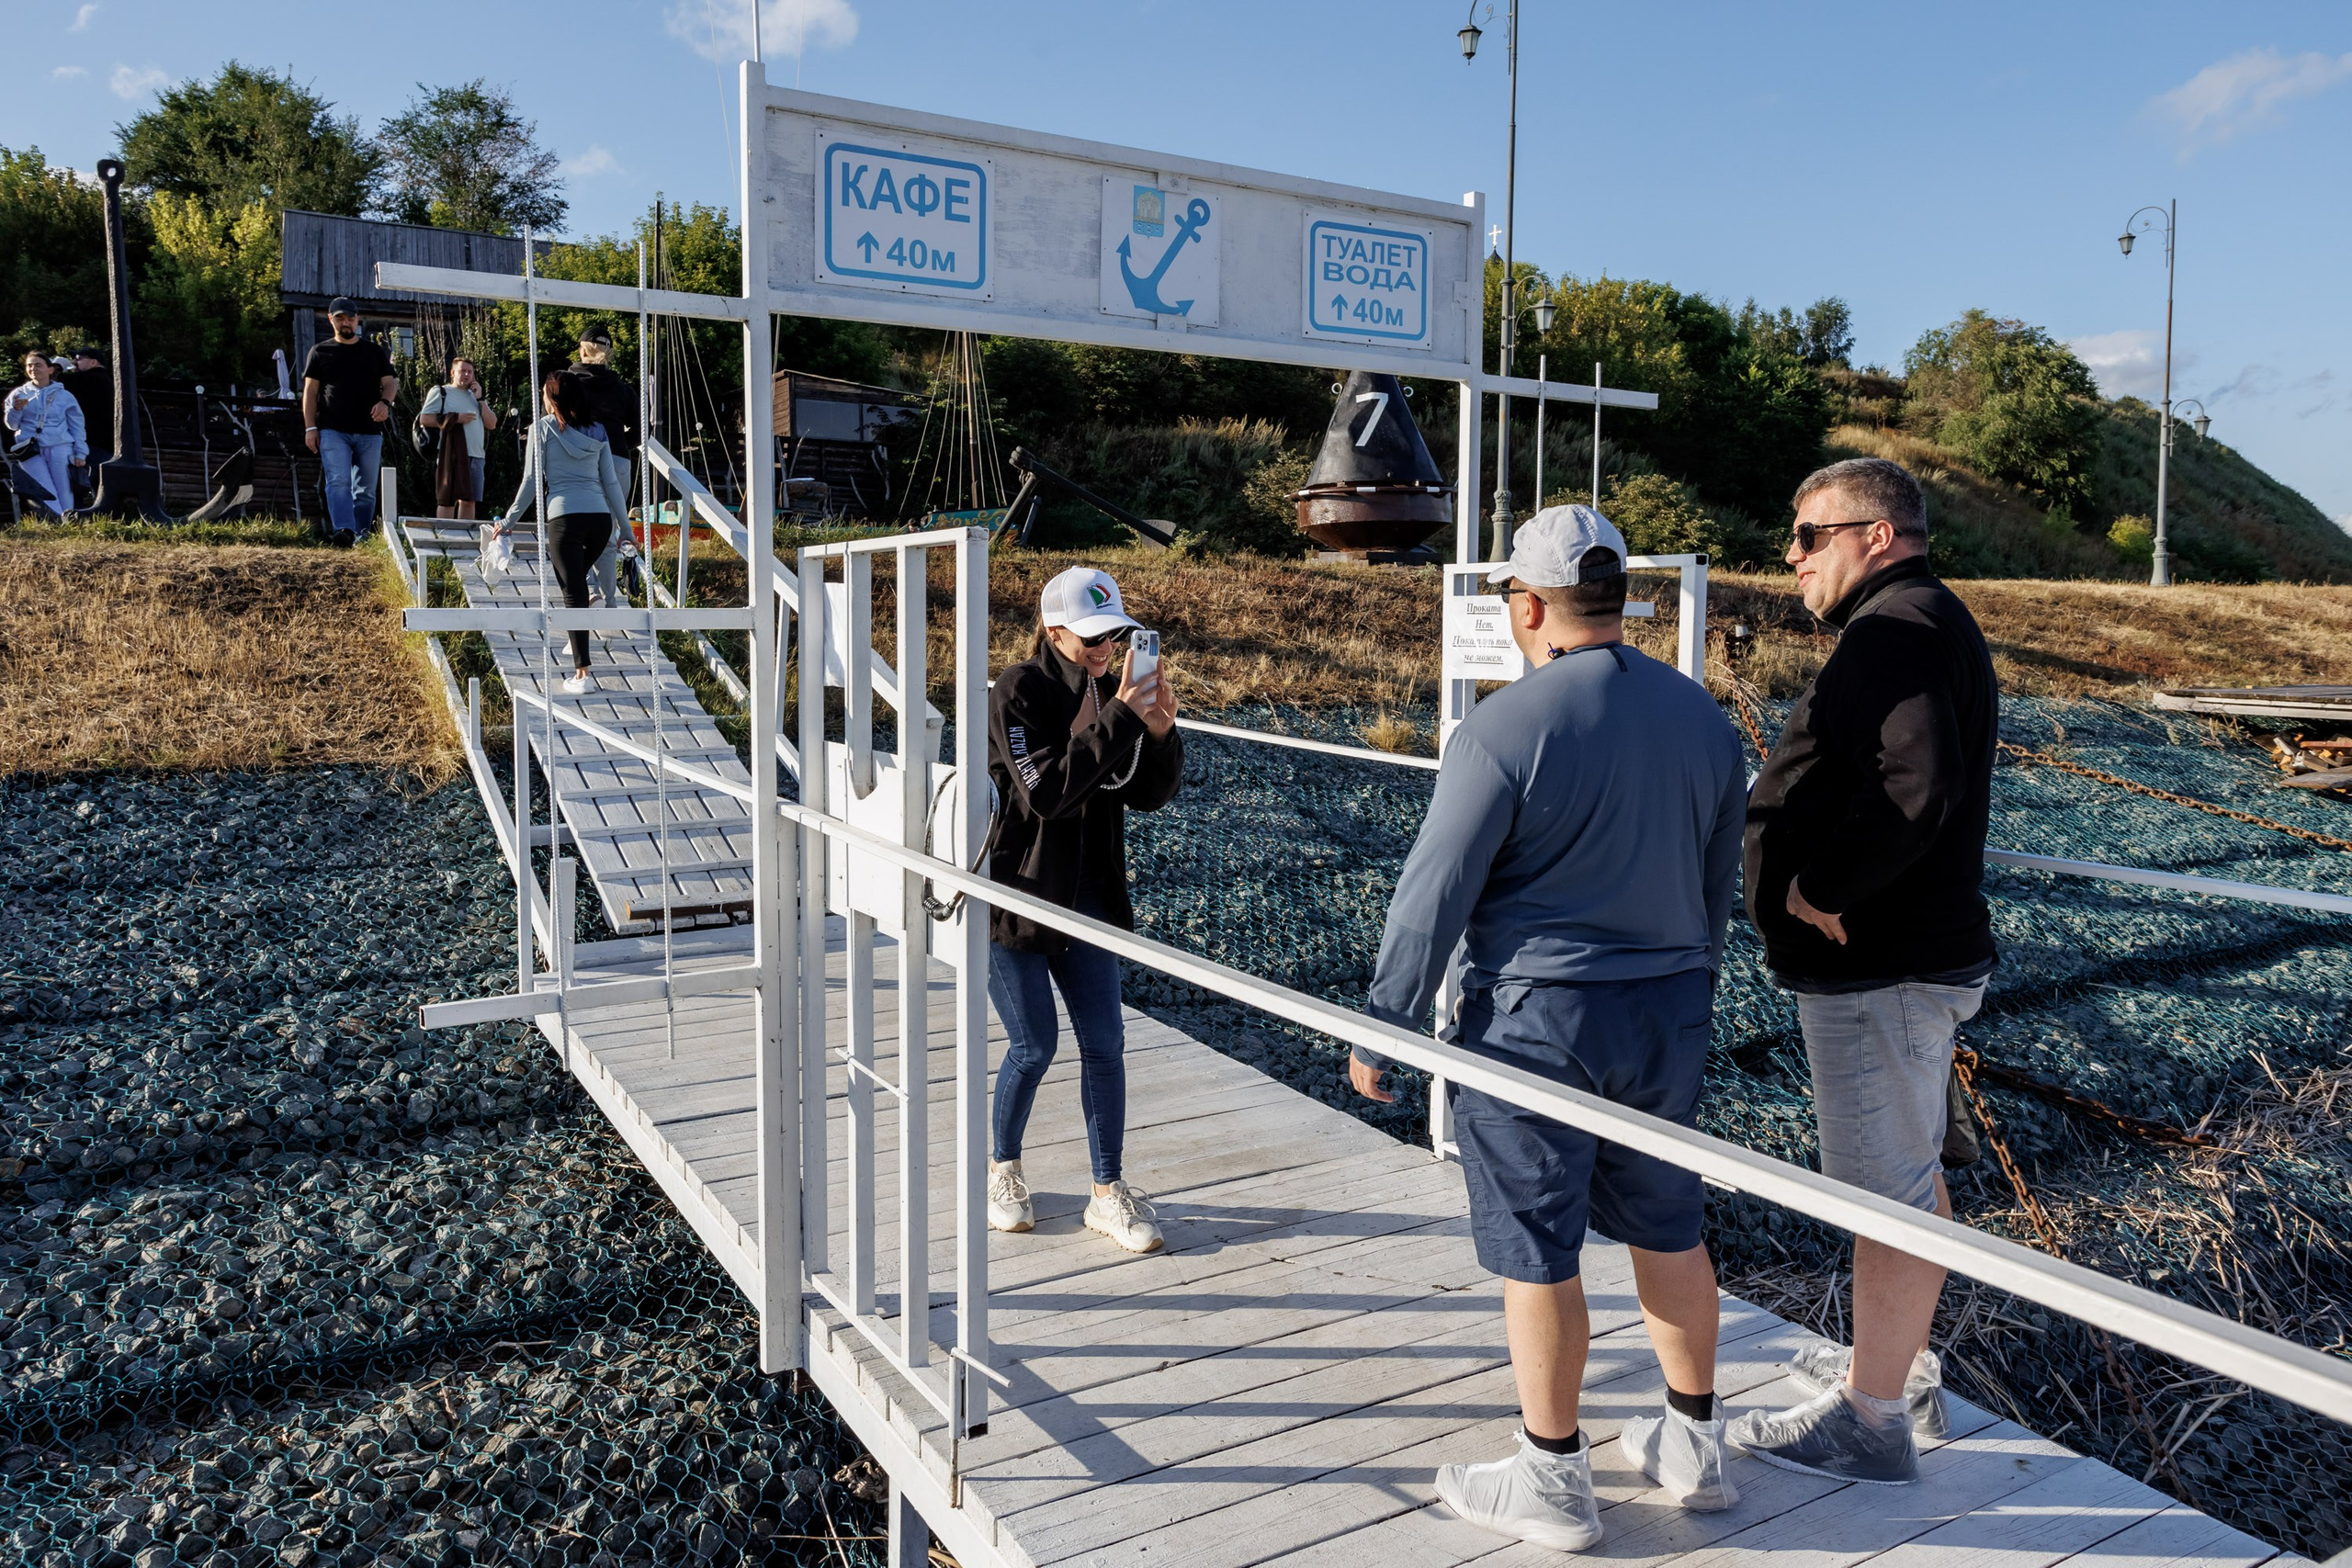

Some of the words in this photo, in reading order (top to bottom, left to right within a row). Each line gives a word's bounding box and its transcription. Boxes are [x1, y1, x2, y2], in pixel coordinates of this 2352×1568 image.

[842, 162, 970, 223] КАФЕ
[1321, 234, 1418, 268] ТУАЛЕТ
[1323, 261, 1417, 292] ВОДА
[1355, 391, 1389, 446] 7
[1466, 603, 1502, 615] Проката
[1475, 619, 1494, 630] Нет.
